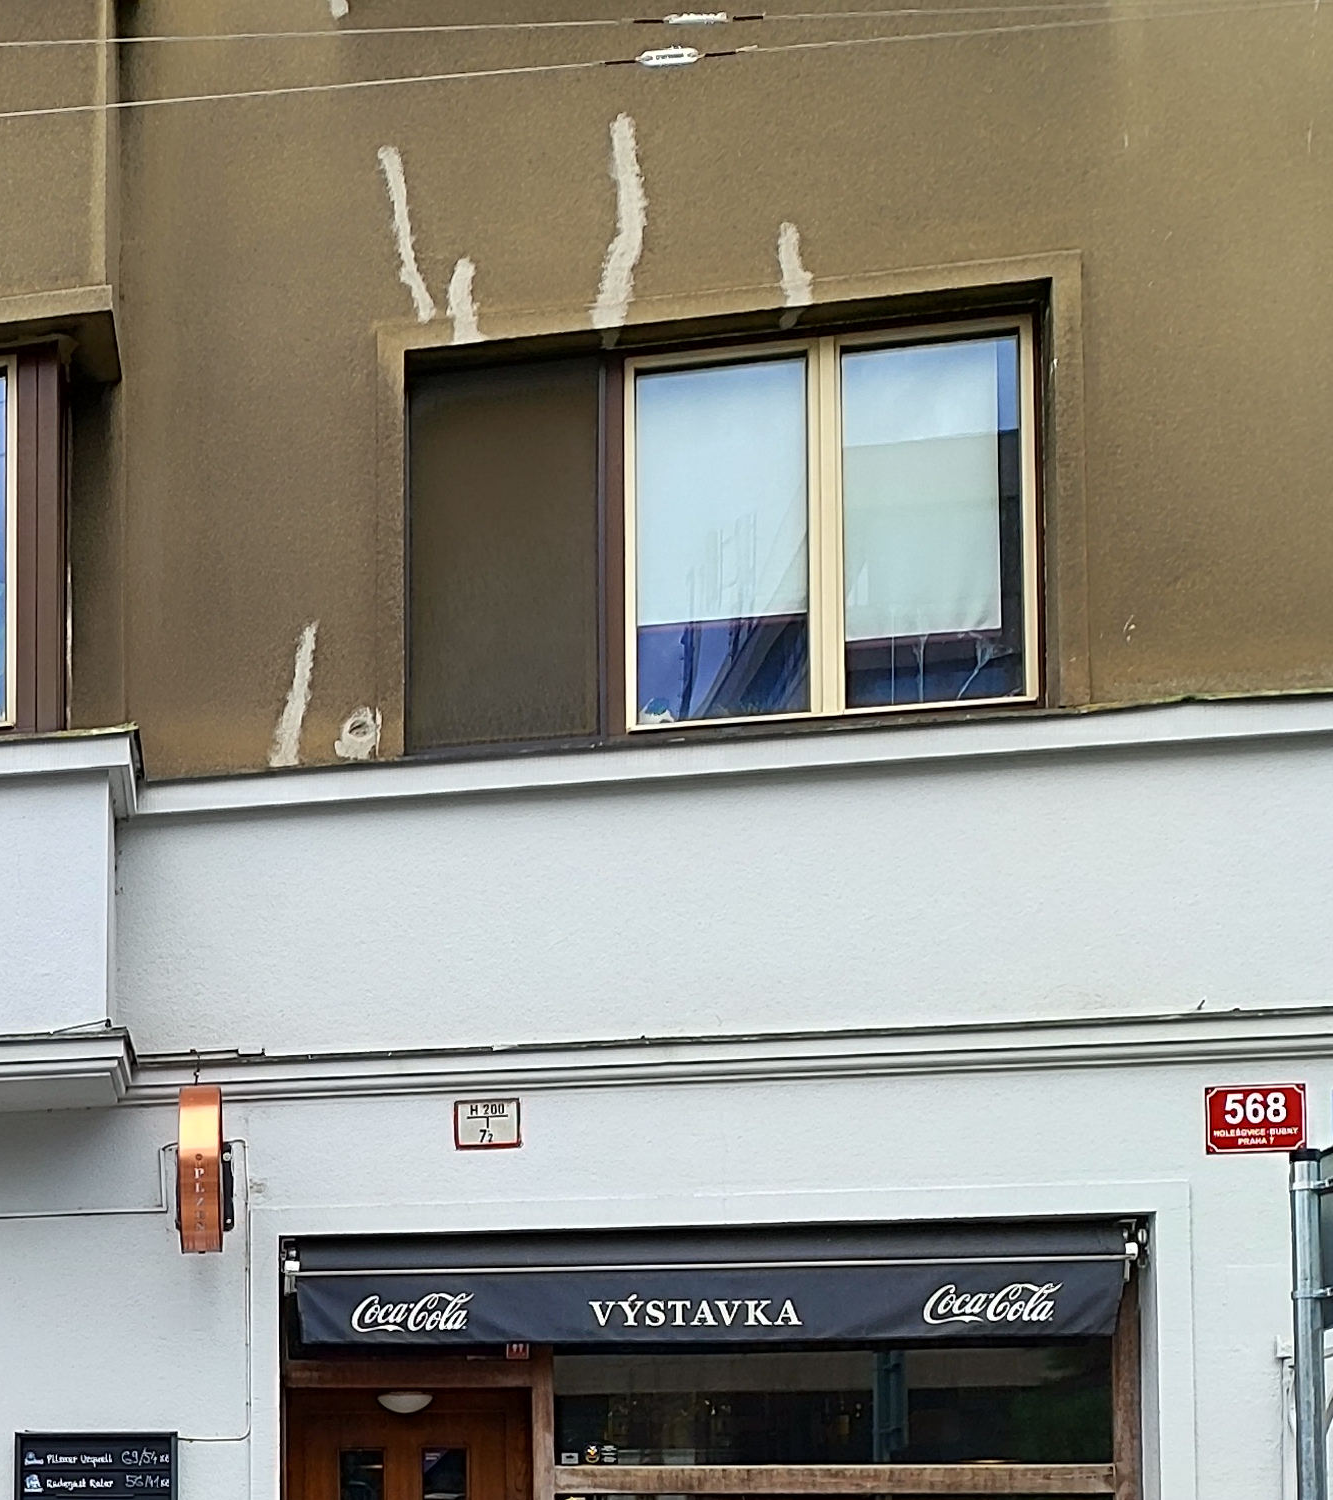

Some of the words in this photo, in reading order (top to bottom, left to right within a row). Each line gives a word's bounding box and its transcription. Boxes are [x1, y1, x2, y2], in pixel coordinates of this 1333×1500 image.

[470, 1105, 478, 1115] H
[483, 1103, 505, 1115] 200
[1225, 1092, 1287, 1125] 568
[1238, 1137, 1267, 1145] PRAHA
[351, 1292, 475, 1333] Coca-Cola
[588, 1293, 803, 1327] VÝSTAVKA
[923, 1282, 1064, 1324] Coca-Cola
